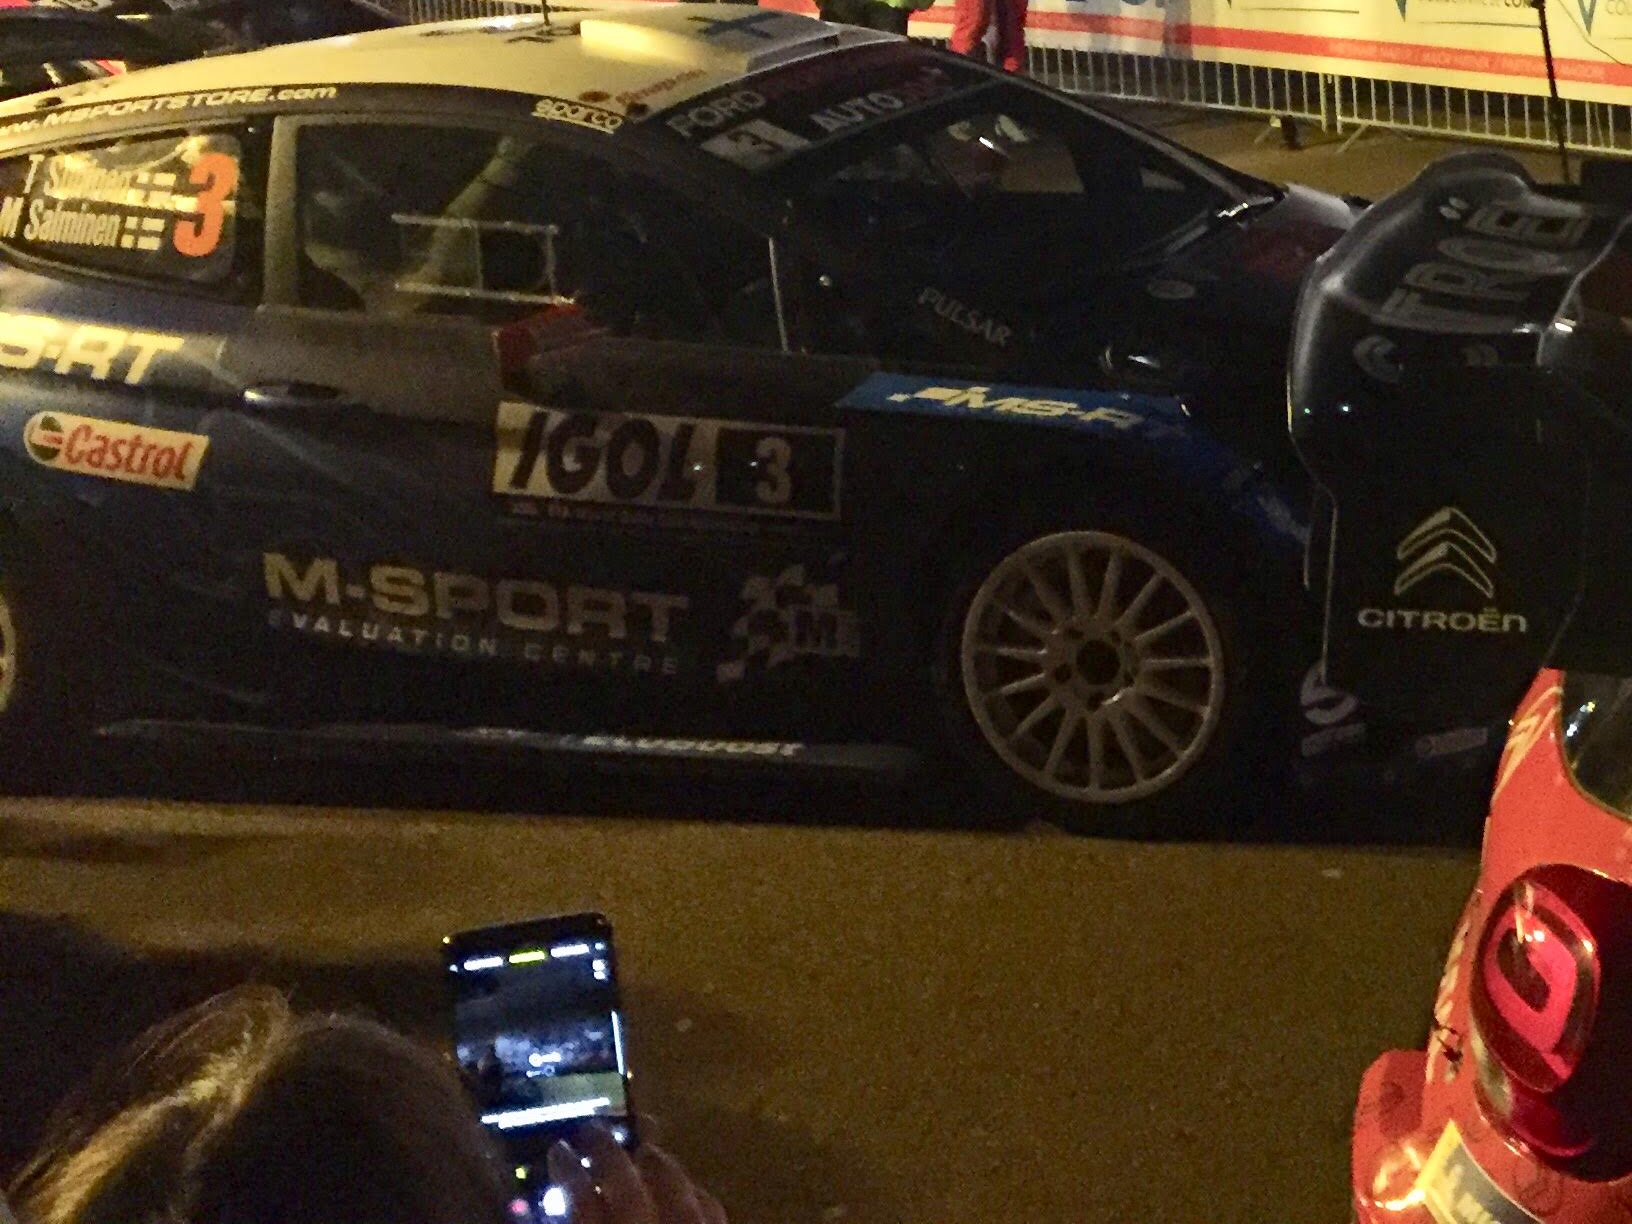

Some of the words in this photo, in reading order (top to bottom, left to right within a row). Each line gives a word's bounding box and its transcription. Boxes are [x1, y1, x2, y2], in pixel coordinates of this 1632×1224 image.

[664, 89, 768, 138] FORD
[24, 154, 45, 194] T
[172, 151, 240, 257] 3
[23, 197, 121, 248] Salminen
[917, 286, 1014, 347] PULSAR
[64, 423, 194, 482] Castrol
[508, 410, 711, 502] IGOL
[754, 436, 792, 504] 3
[262, 551, 690, 644] M-SPORT
[268, 608, 498, 658] EVALUATION
[524, 642, 679, 677] CENTRE
